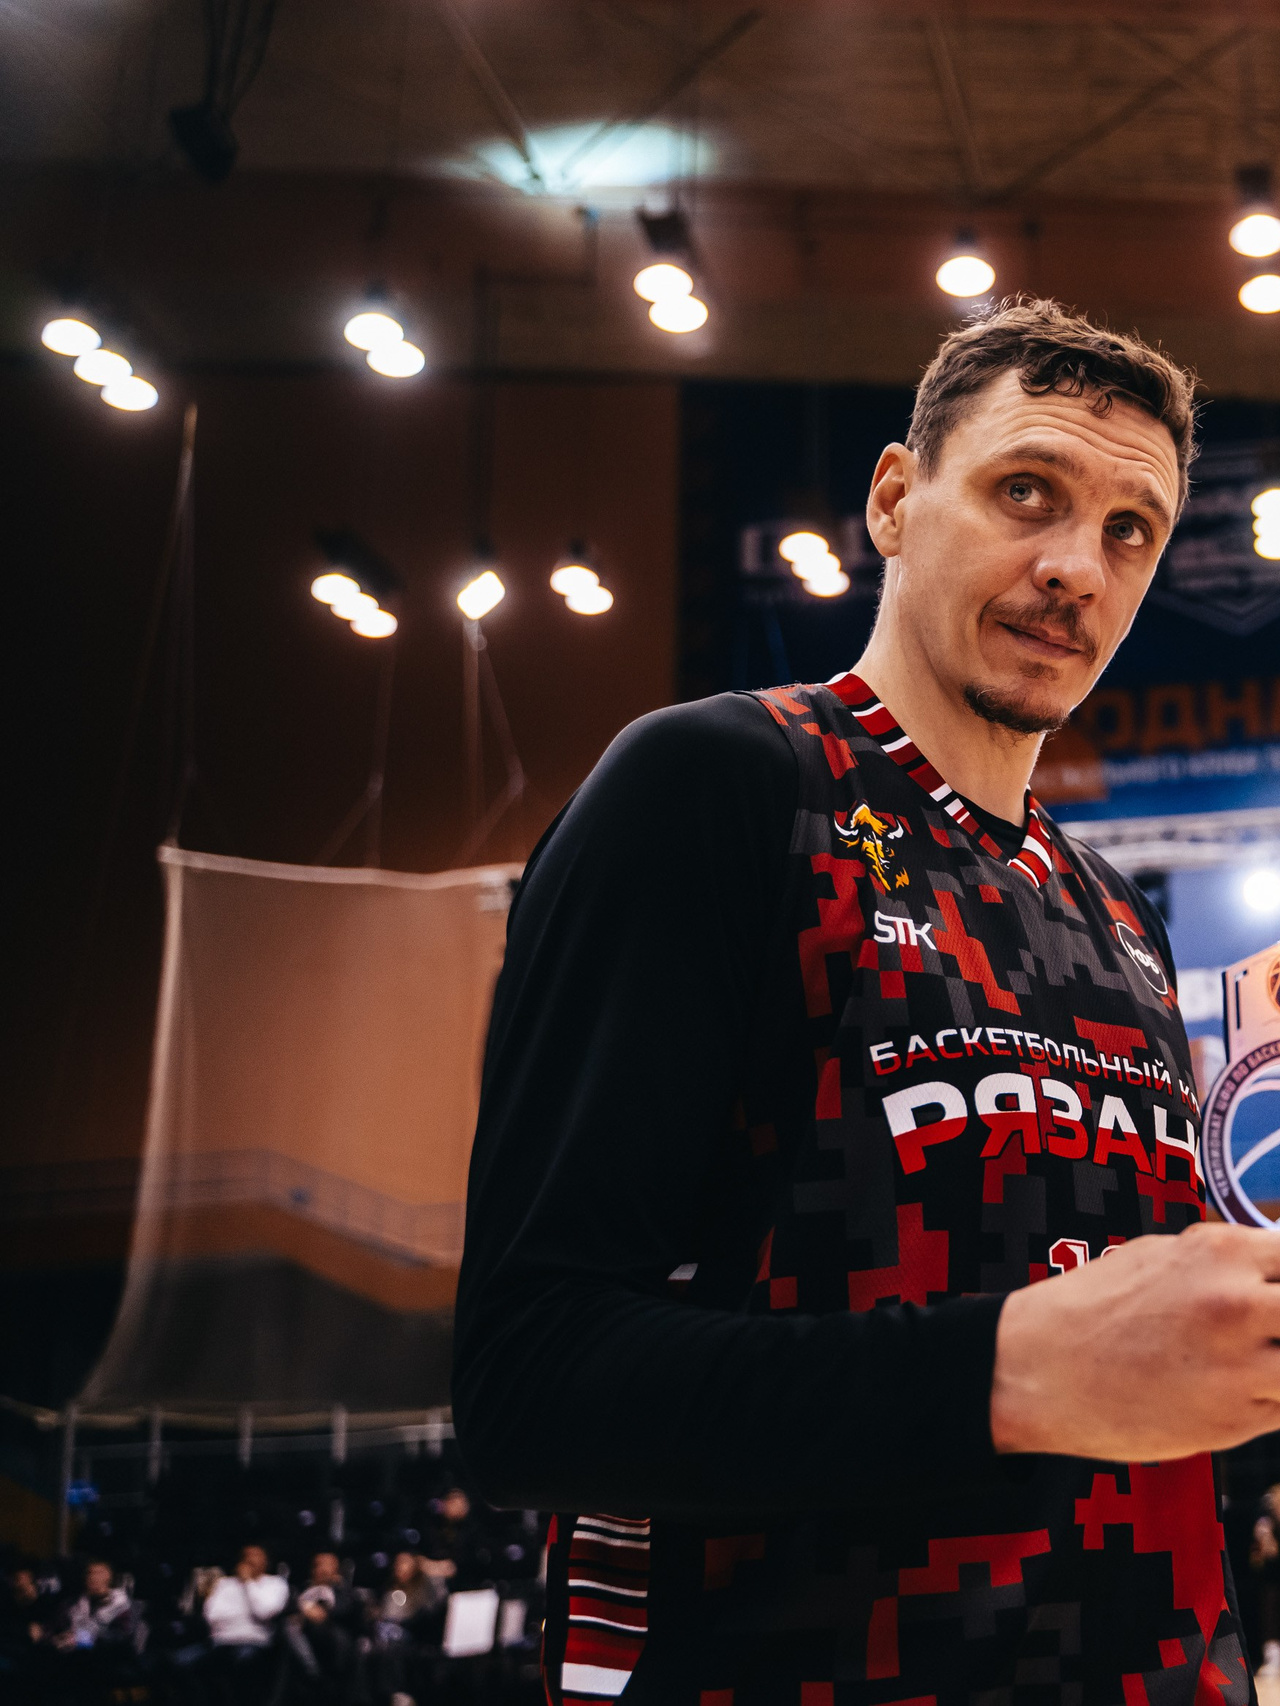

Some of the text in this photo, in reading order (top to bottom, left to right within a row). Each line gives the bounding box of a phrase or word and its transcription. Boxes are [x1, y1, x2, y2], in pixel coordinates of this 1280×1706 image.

[873, 910, 937, 950] STK
[869, 1027, 1173, 1096] БАСКЕТБОЛЬНЫЙ
[881, 1072, 1206, 1193] РЯЗАН
